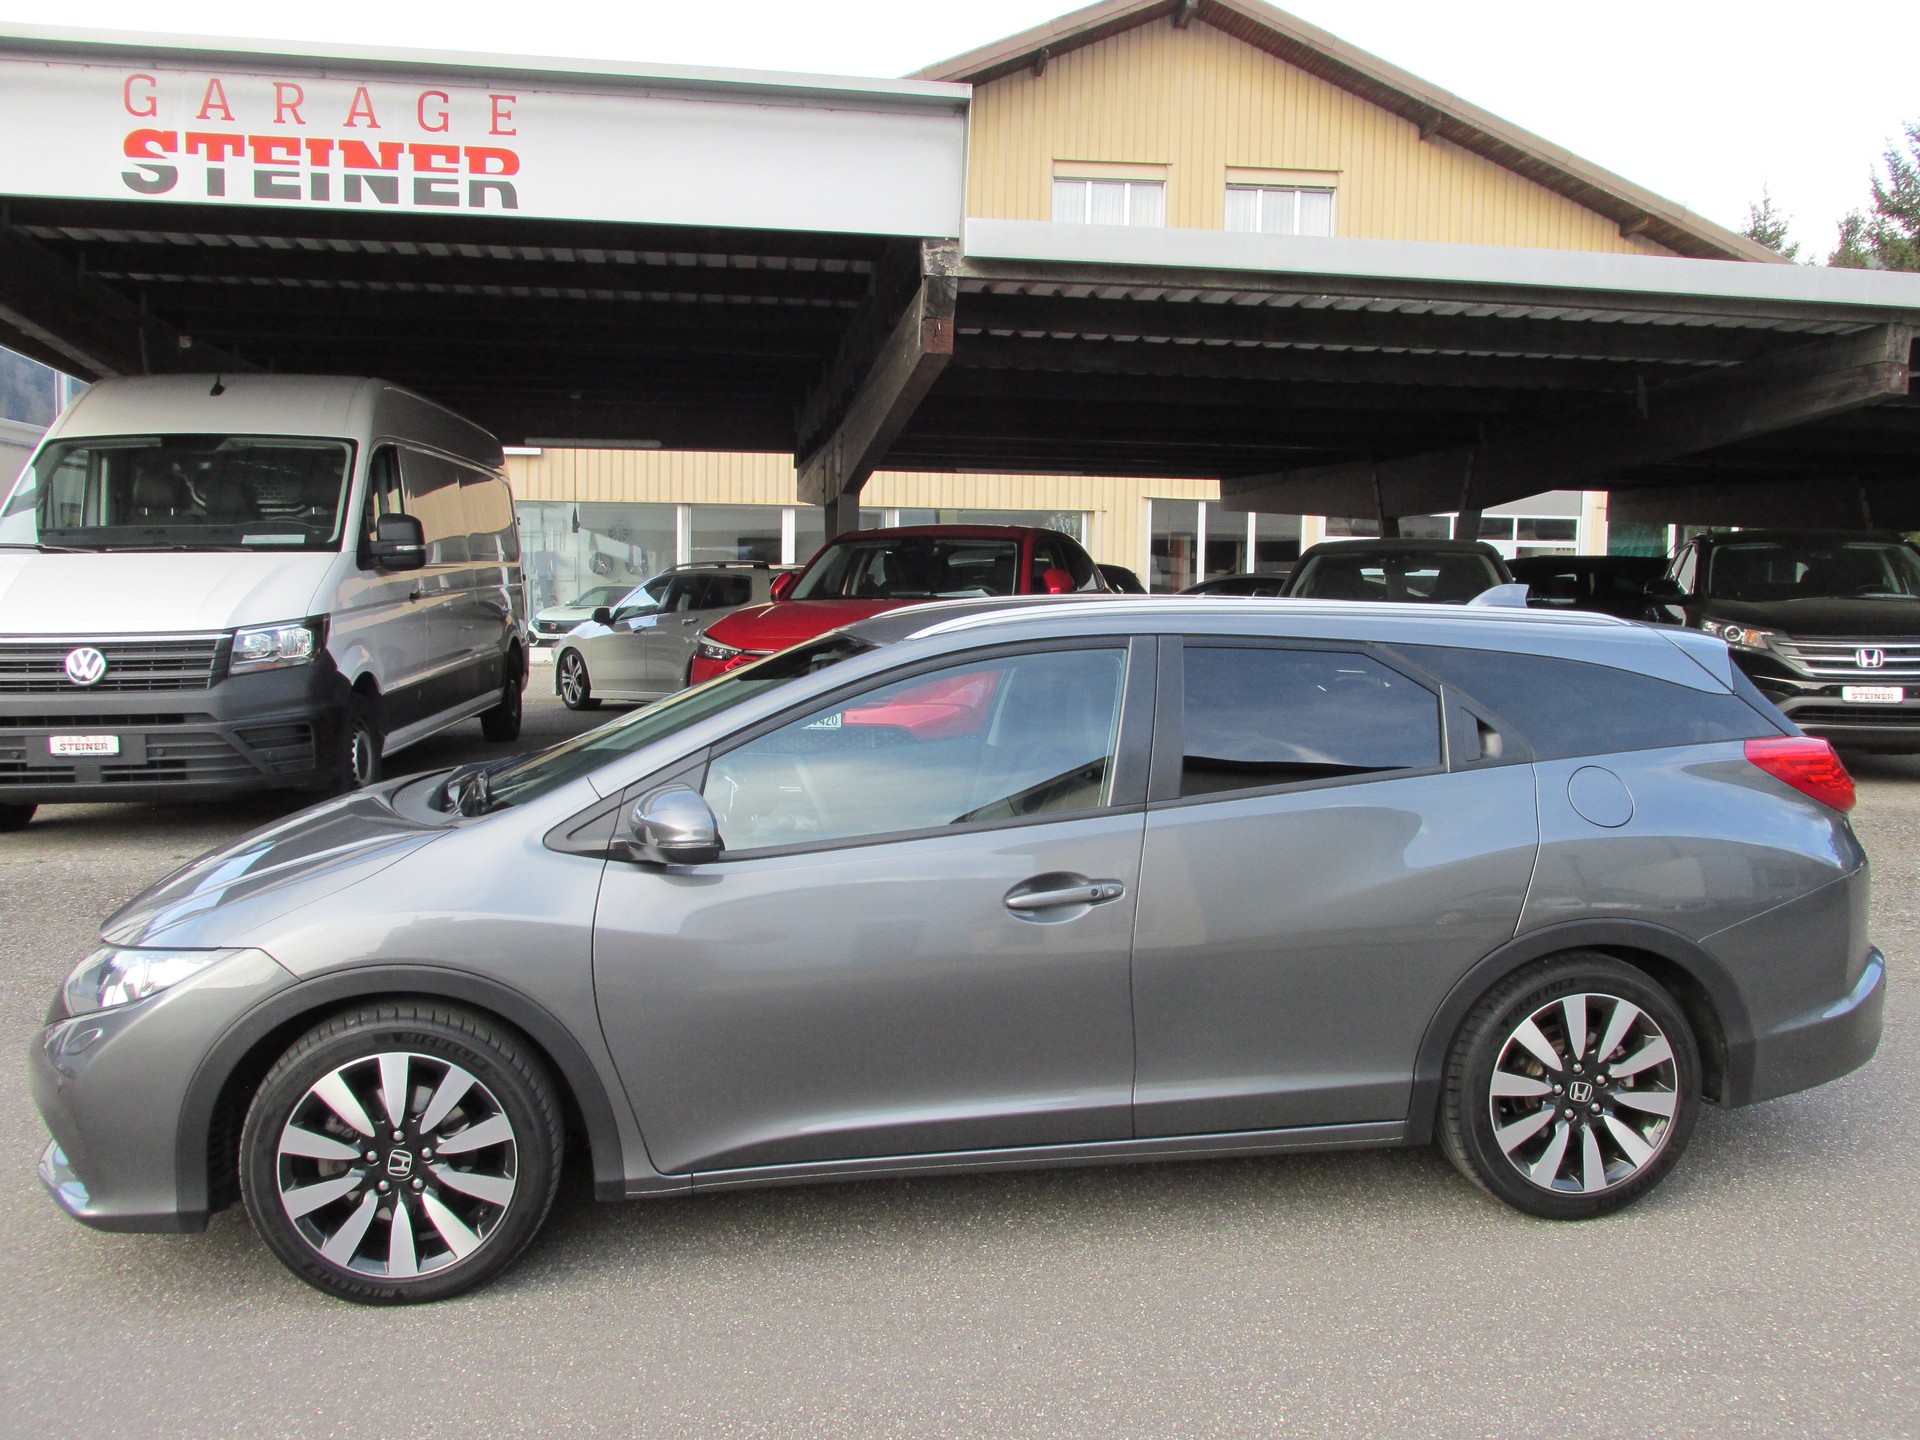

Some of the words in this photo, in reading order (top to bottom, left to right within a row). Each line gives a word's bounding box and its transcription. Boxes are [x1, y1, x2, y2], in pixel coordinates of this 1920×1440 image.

[123, 73, 516, 136] GARAGE
[121, 128, 520, 209] STEINER
[59, 742, 108, 751] STEINER
